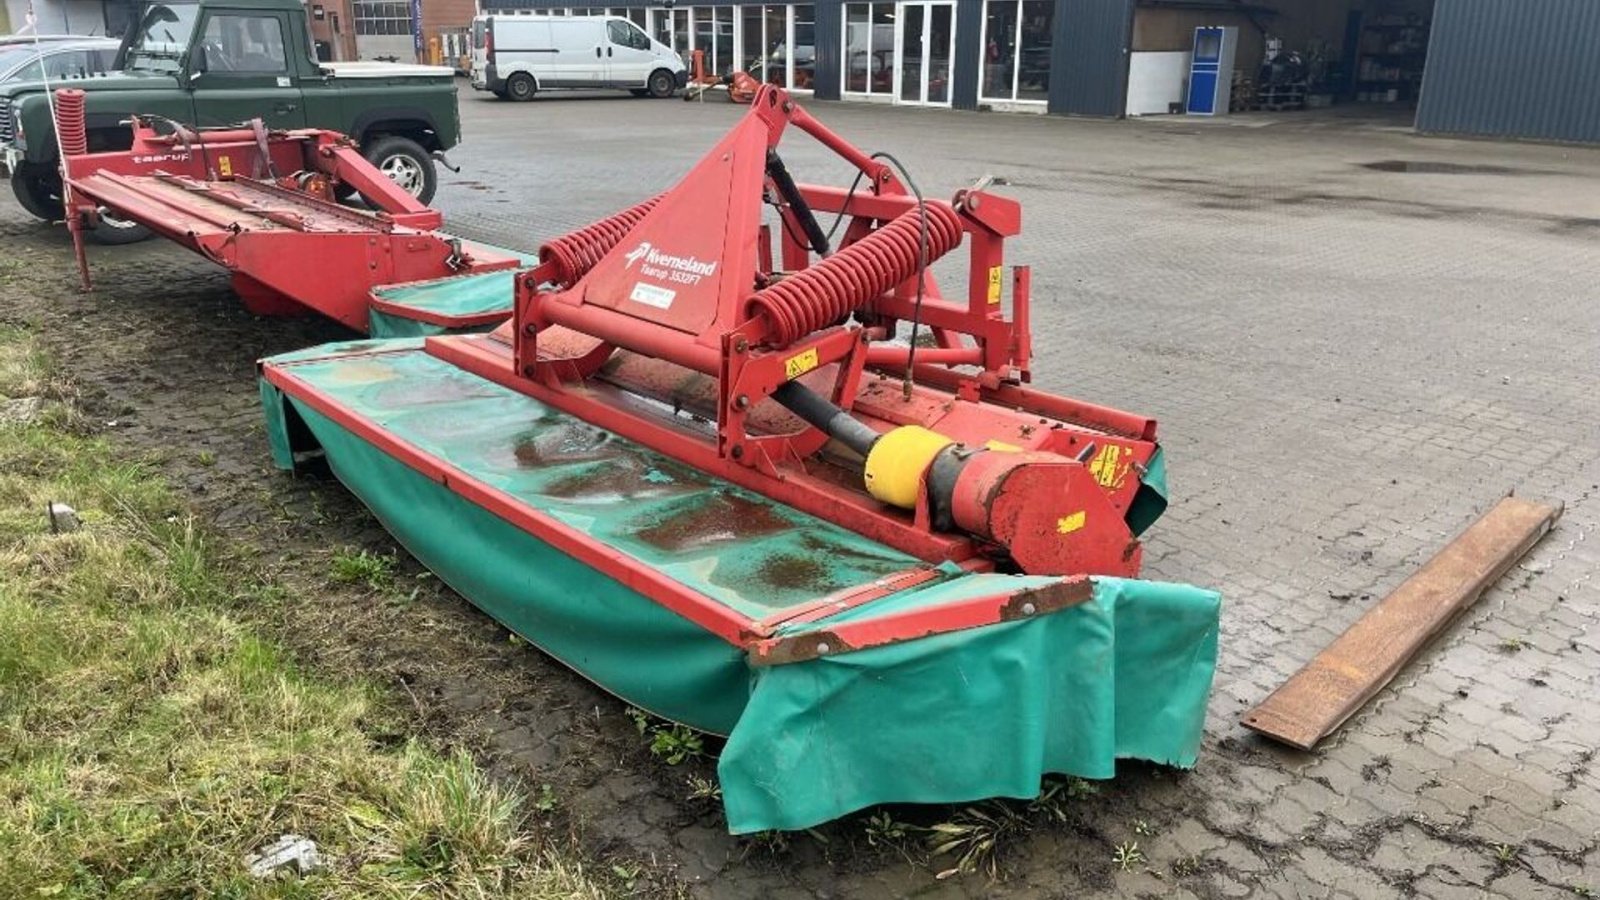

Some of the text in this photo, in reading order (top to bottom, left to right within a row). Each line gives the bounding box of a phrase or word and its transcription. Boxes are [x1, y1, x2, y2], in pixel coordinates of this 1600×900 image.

[133, 153, 189, 164] taarup
[645, 248, 717, 276] Kverneland
[640, 263, 668, 281] Taarup
